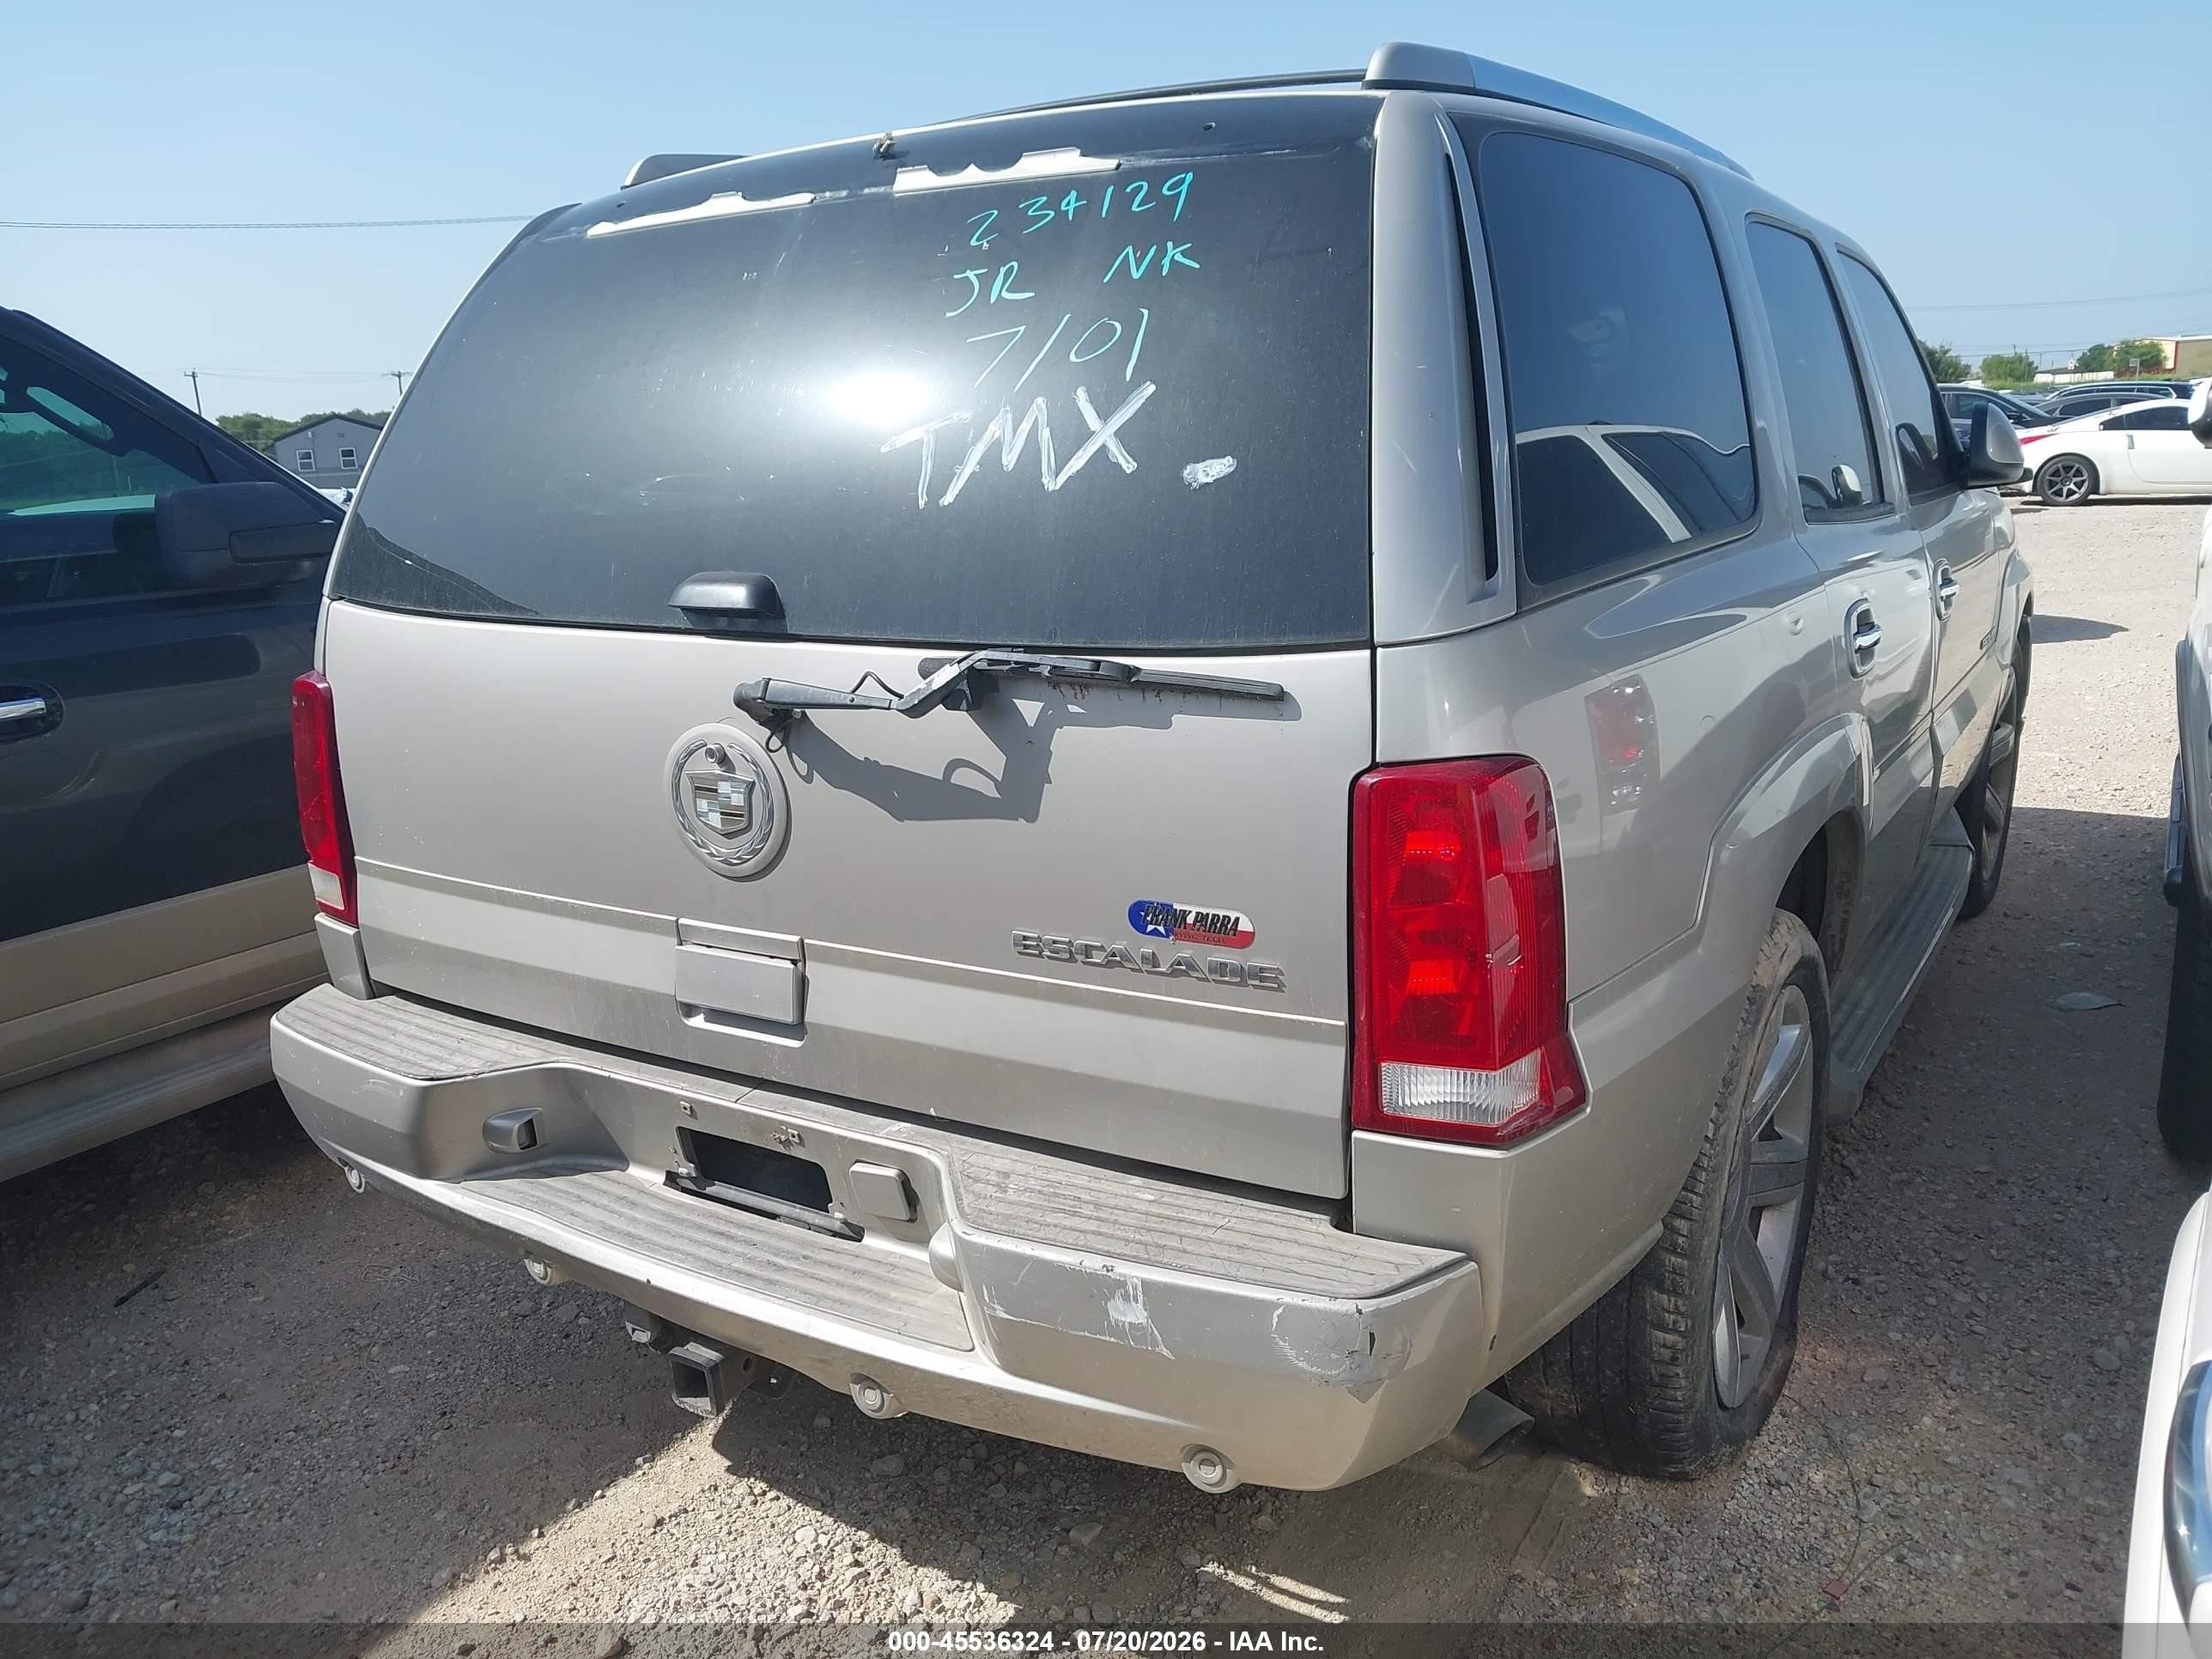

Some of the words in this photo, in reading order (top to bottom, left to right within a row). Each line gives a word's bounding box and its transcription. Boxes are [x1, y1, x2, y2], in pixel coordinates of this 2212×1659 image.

[945, 260, 1036, 318] JR
[1103, 240, 1200, 284] NK
[880, 380, 1156, 509] TMX
[1141, 904, 1190, 930] FRANK
[1191, 910, 1241, 937] PARRA
[1012, 930, 1286, 989] ESCALADE
